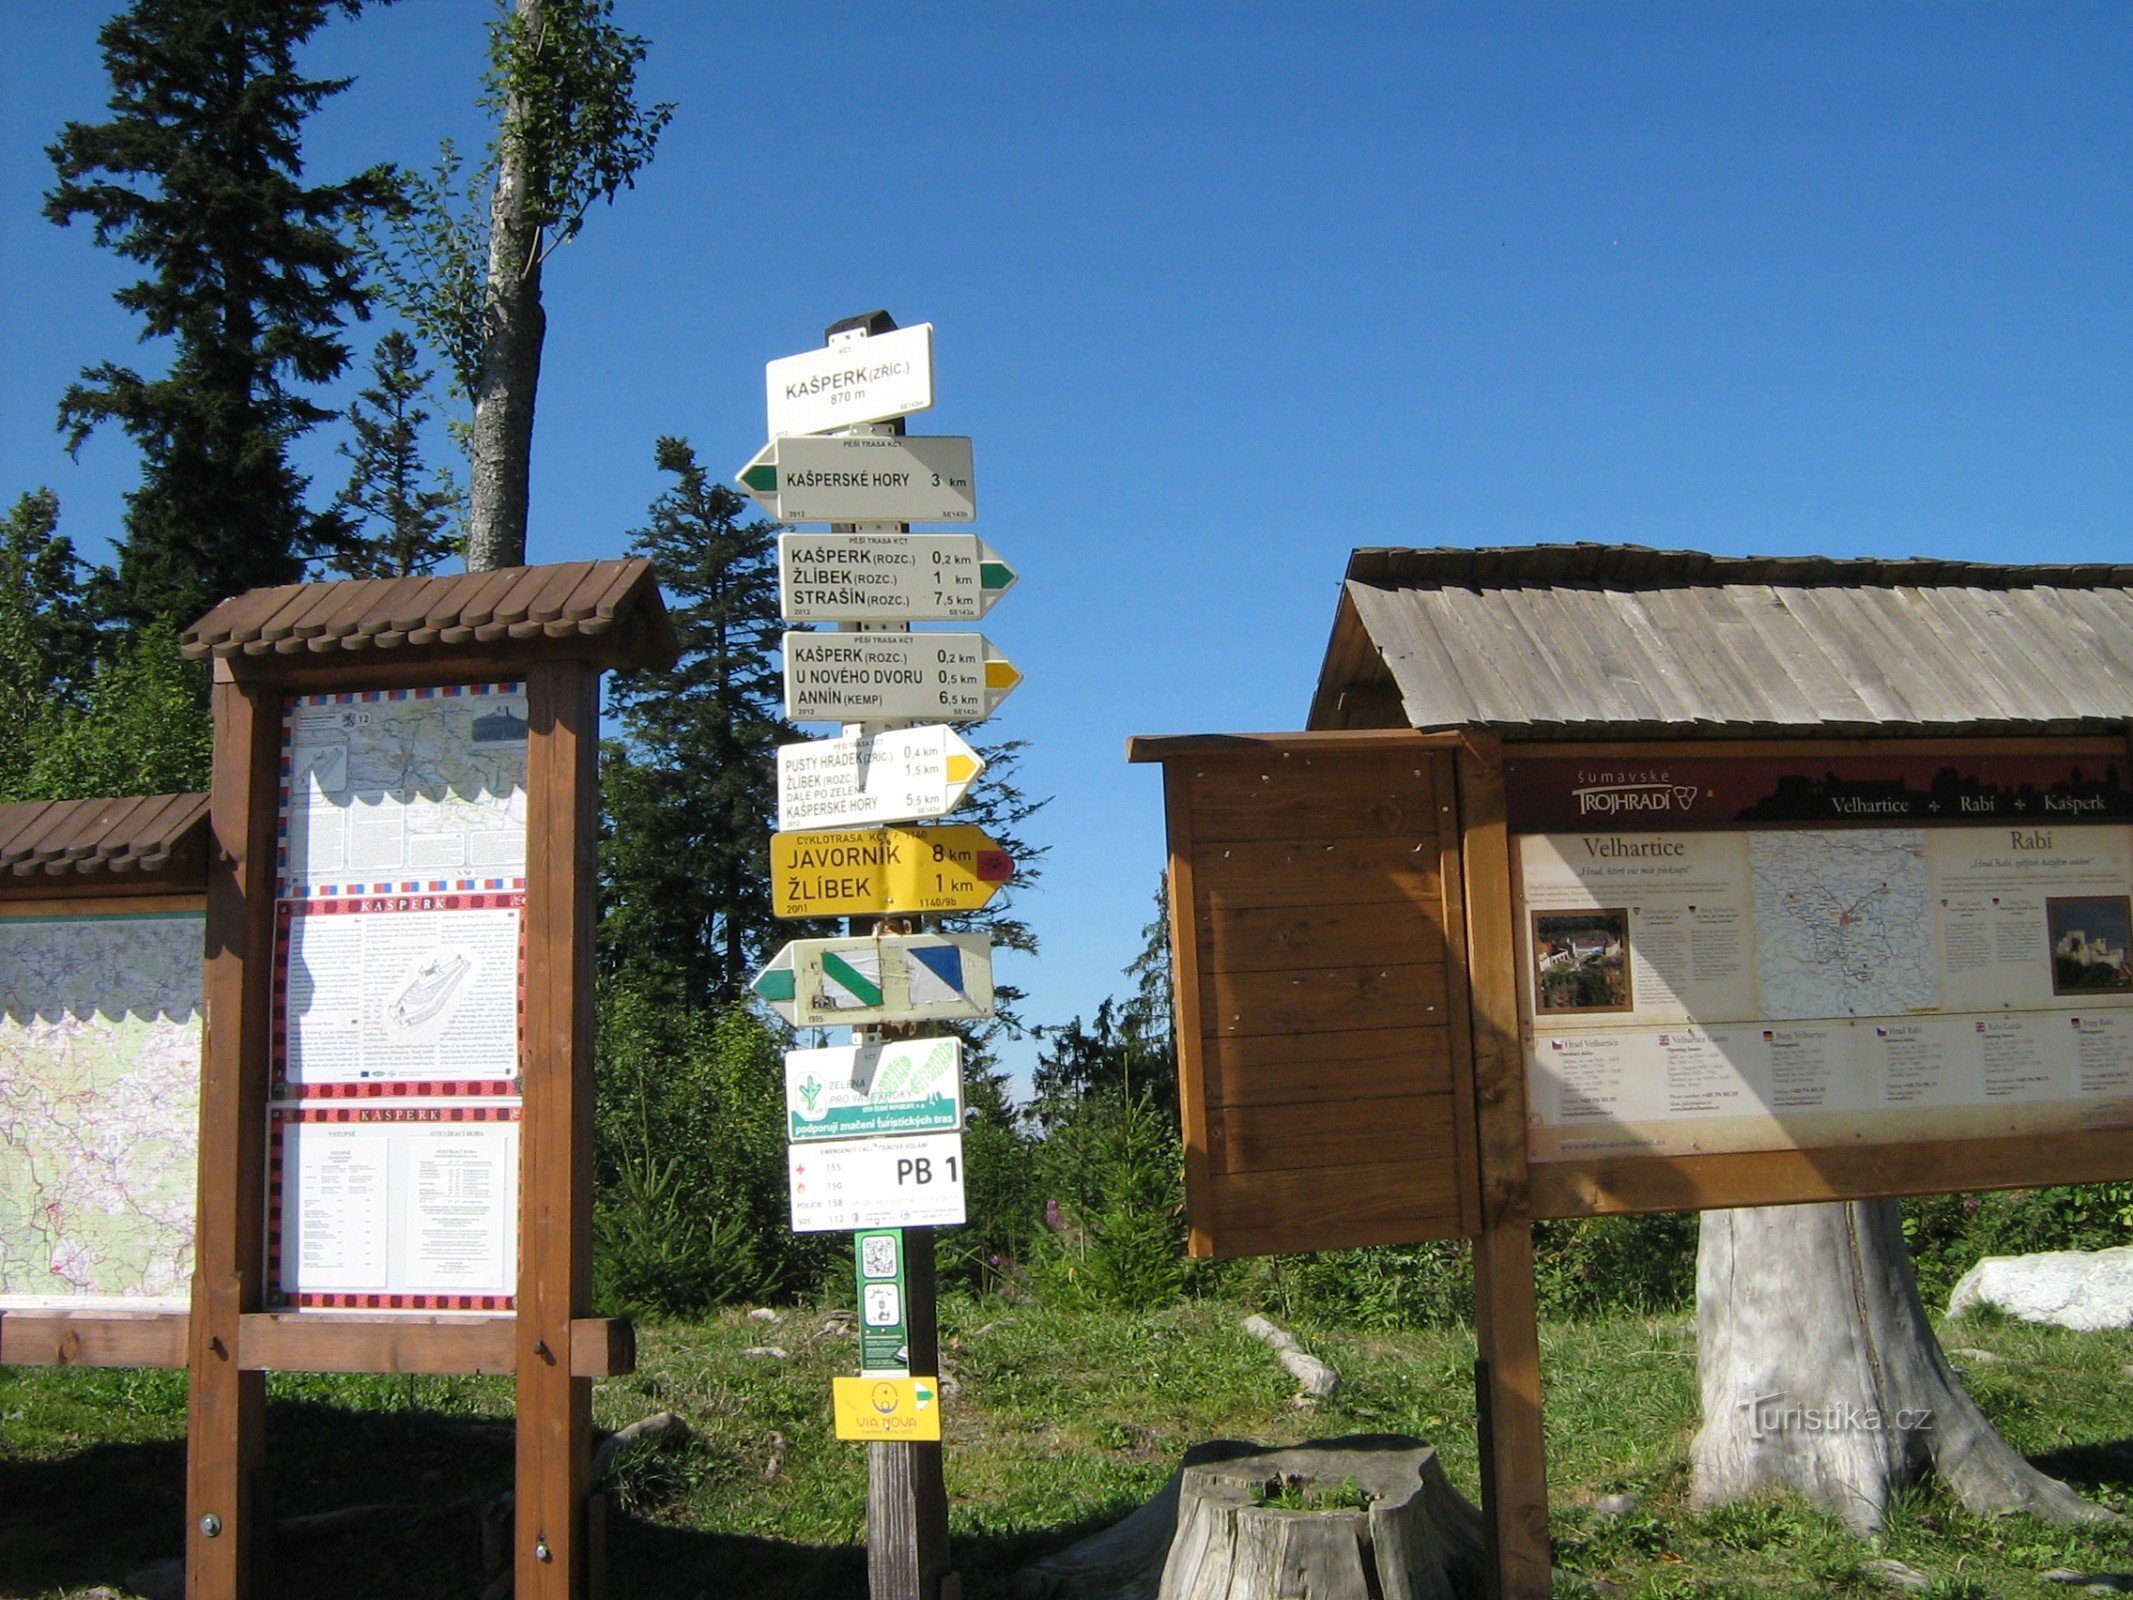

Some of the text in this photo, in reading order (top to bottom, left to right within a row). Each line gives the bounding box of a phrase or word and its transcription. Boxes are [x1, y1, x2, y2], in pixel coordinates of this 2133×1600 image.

[785, 361, 910, 400] KAŠPERK (ZŘÍC.)
[830, 389, 866, 405] 870 m
[787, 470, 967, 487] KAŠPERSKÉ HORY 3 km
[791, 546, 972, 566] KAŠPERK (ROZC.) 0,2 km
[792, 567, 973, 586] ŽLÍBEK (ROZC.) 1 km
[793, 588, 974, 608] STRAŠÍN (ROZC.) 7,5 km
[795, 645, 976, 665] KAŠPERK (ROZC.) 0,2 km
[796, 667, 978, 685] U NOVÉHO DVORU 0,5 km
[797, 687, 979, 707] ANNÍN (KEMP) 6,5 km
[358, 714, 370, 723] 12
[785, 754, 818, 773] PUSTÝ
[820, 751, 863, 769] HRÁDEK
[904, 745, 920, 760] 0,4
[923, 746, 939, 757] km
[786, 763, 940, 791] ŽLÍBEK (ROZC.) 1,5 km
[1577, 768, 1670, 783] šumavské
[814, 789, 828, 799] PO
[829, 782, 867, 798] ZELENÉ
[1571, 783, 1674, 816] TROJHRADÍ
[786, 793, 940, 819] KAŠPERSKÉ HORY 5,5 km
[1831, 793, 2106, 815] Velhartice Rabí Kašperk
[796, 833, 863, 845] CYKLOTRASA
[869, 832, 888, 843] KČT
[906, 830, 927, 840] 1140
[1583, 836, 1685, 858] Velhartice
[2010, 830, 2053, 851] Rabí
[787, 840, 972, 870] JAVORNÍK 8 km
[787, 873, 974, 901] ŽLÍBEK 1 km
[919, 897, 957, 908] 1140/9b
[829, 1076, 866, 1090] ZELENÁ
[829, 1095, 849, 1105] PRO
[795, 1113, 954, 1136] podporují značení turistických tras
[826, 1162, 842, 1172] 155
[897, 1156, 957, 1186] PB 1
[827, 1181, 843, 1191] 150
[796, 1199, 843, 1209] POLICIE 158
[798, 1215, 844, 1226] SOS 112
[856, 1416, 918, 1428] VIA NOVA
